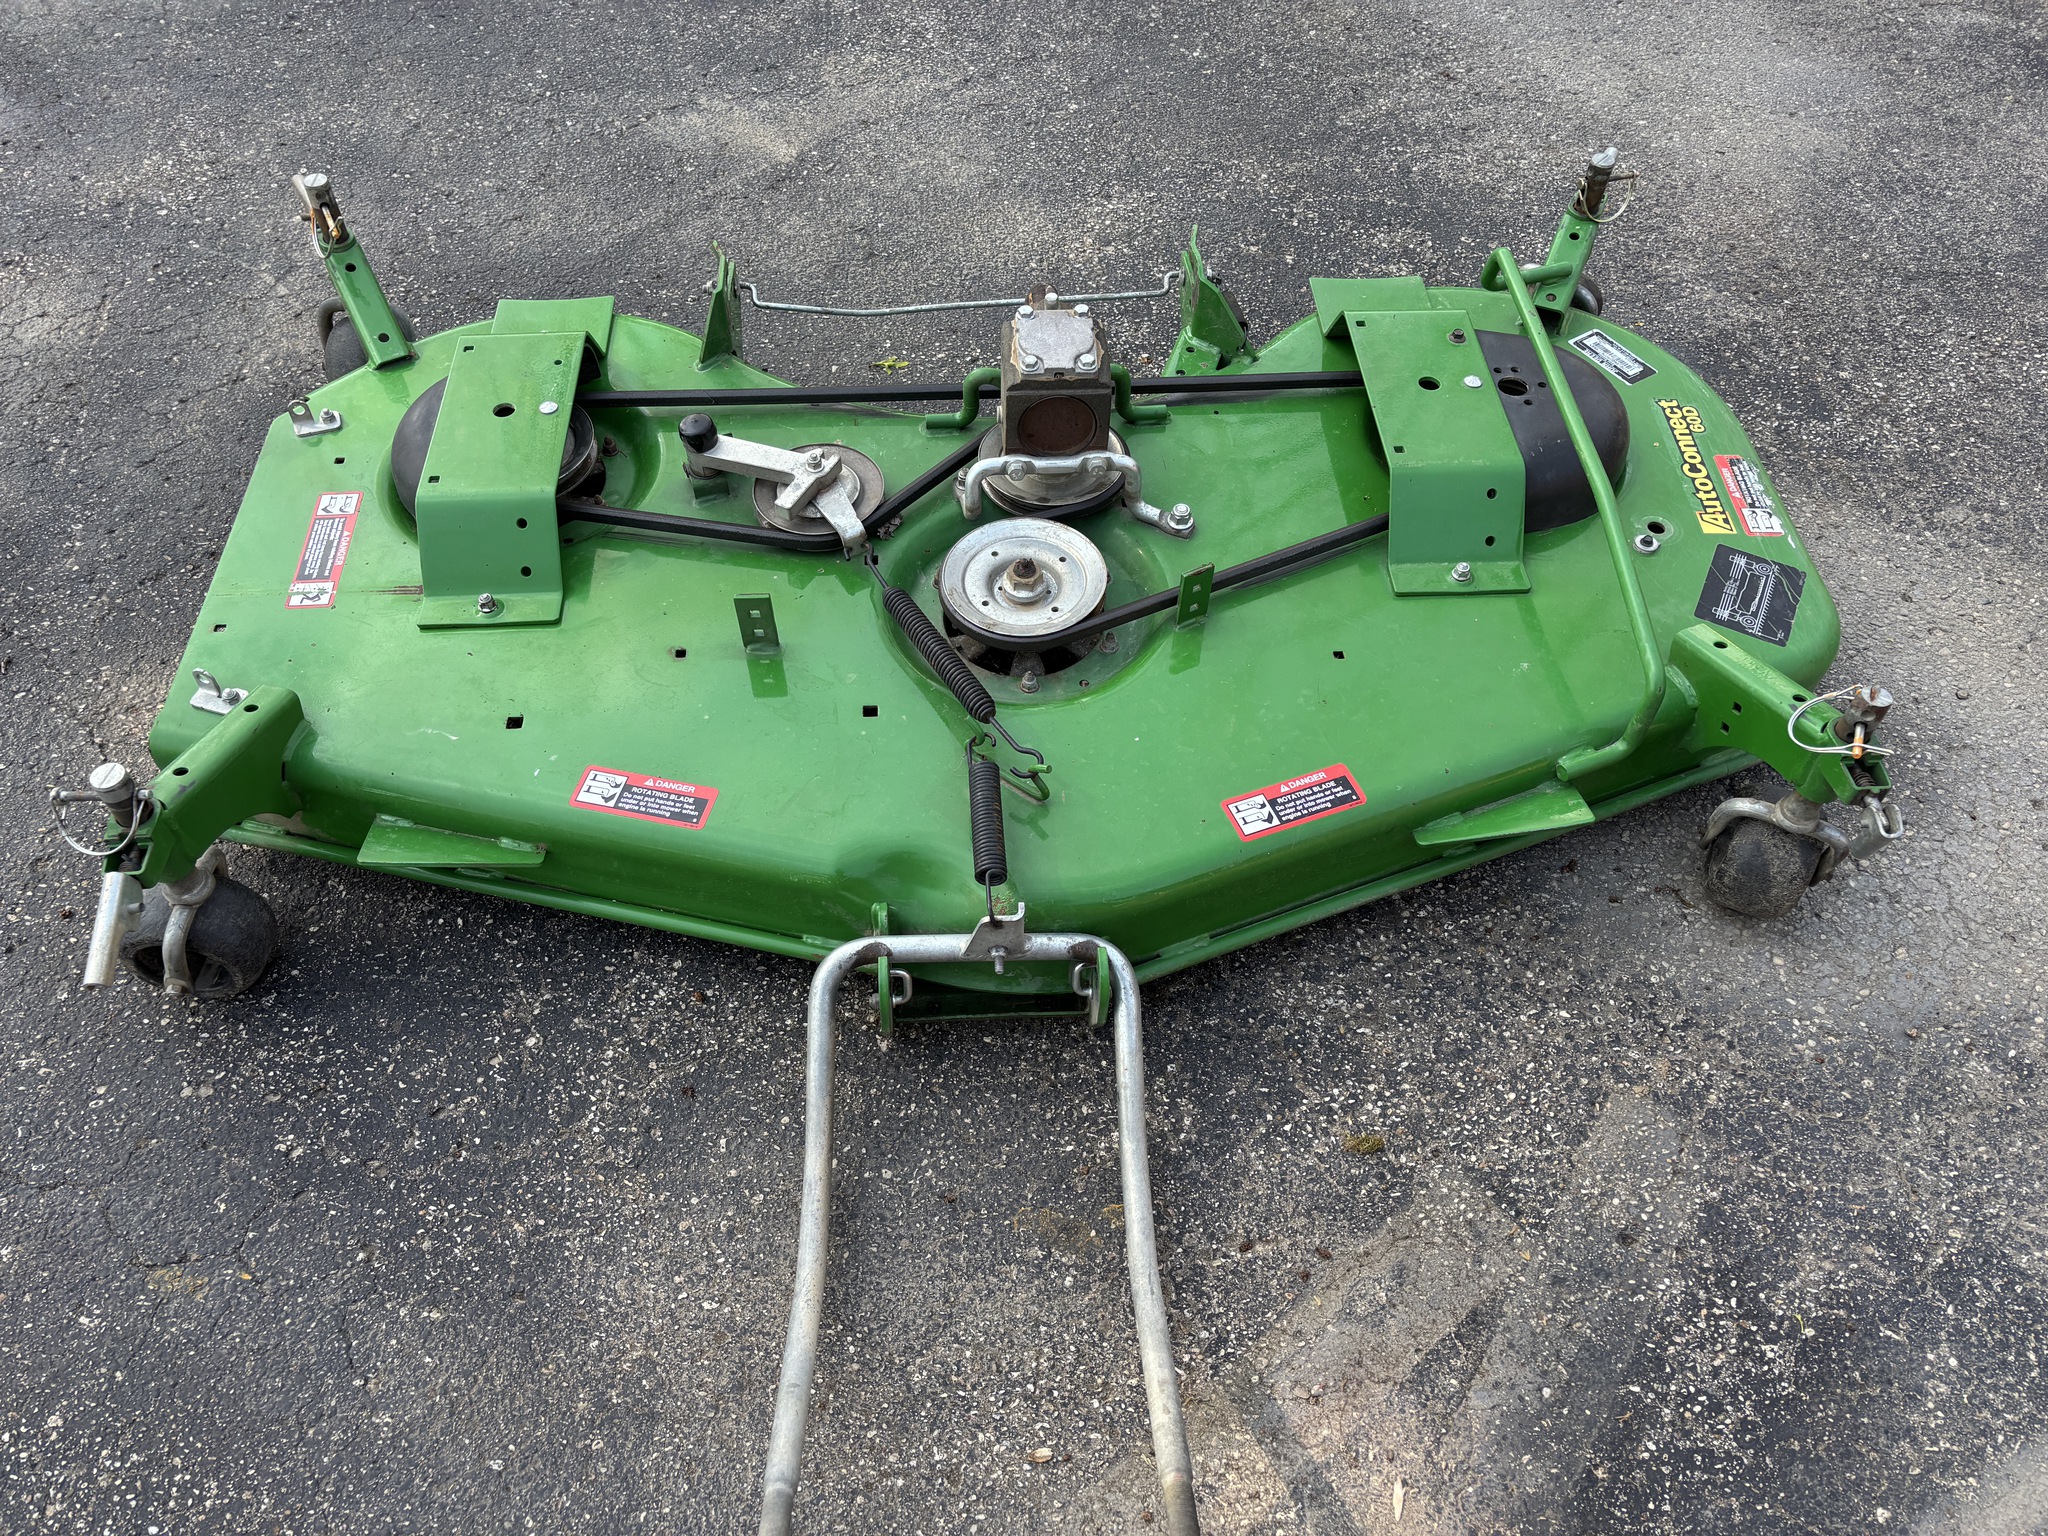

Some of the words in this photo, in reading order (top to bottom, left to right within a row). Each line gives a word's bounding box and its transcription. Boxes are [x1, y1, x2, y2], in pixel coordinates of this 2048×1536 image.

[1682, 406, 1706, 433] 60D
[1656, 398, 1734, 532] AutoConnect
[1722, 468, 1737, 491] DANGER
[335, 537, 349, 565] DANGER
[655, 780, 695, 793] DANGER
[1288, 771, 1326, 788] DANGER
[632, 787, 668, 798] ROTATING
[669, 794, 694, 803] BLADE
[1277, 788, 1312, 803] ROTATING
[1312, 780, 1336, 791] BLADE
[1278, 807, 1296, 816] under
[1315, 794, 1335, 803] mower
[1335, 788, 1351, 796] when
[1306, 792, 1324, 800] hands
[617, 802, 638, 810] engine
[646, 808, 670, 816] running
[1282, 811, 1302, 821] engine
[1308, 801, 1331, 813] running
